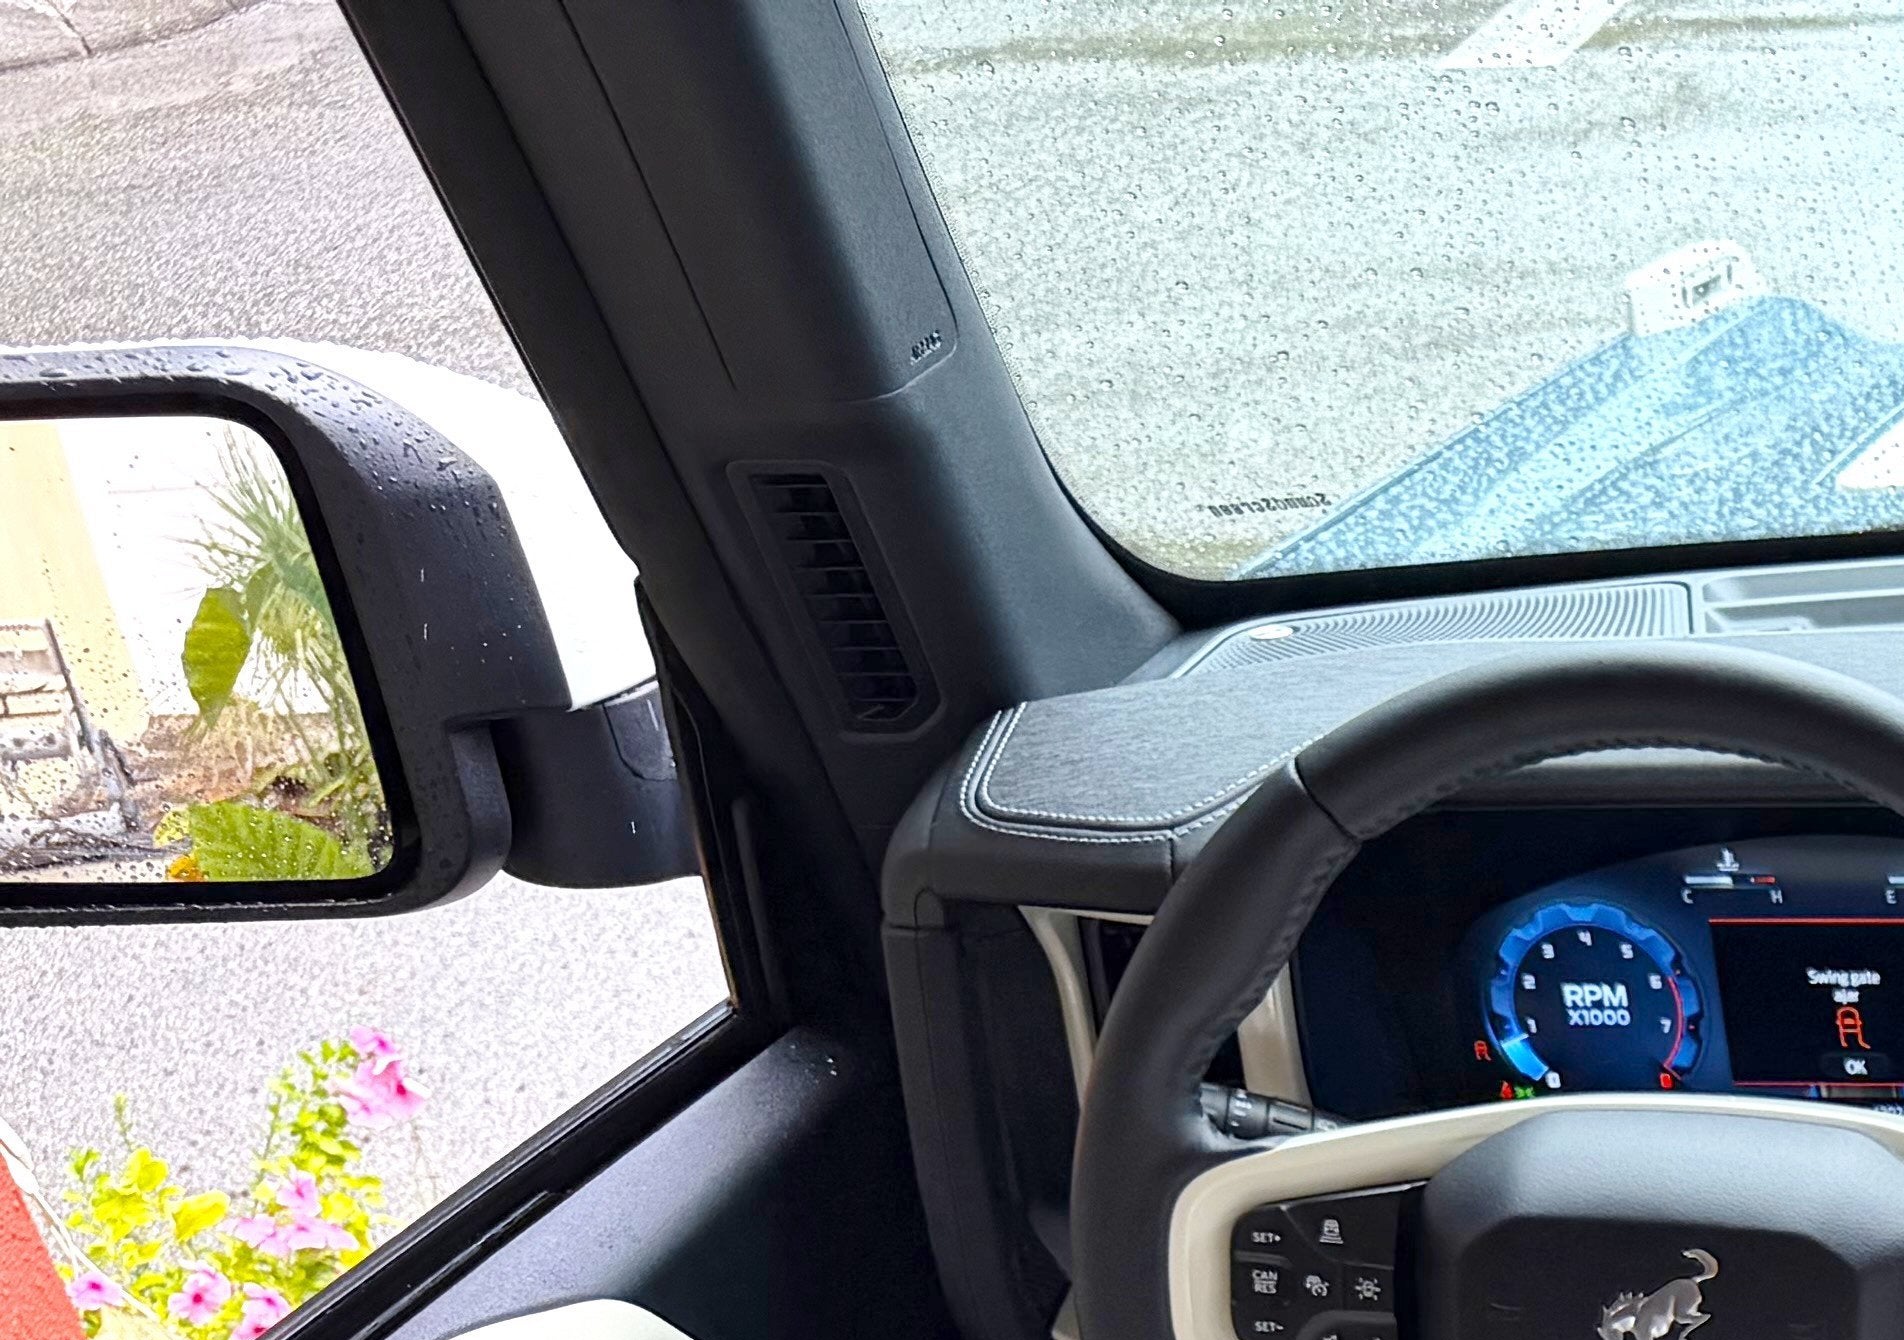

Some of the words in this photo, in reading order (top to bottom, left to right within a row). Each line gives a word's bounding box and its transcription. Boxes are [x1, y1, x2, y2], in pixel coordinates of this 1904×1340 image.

[1681, 888, 1694, 904] C
[1770, 889, 1783, 904] H
[1885, 888, 1897, 904] E
[1577, 930, 1592, 946] 4
[1541, 943, 1555, 959] 3
[1620, 943, 1634, 959] 5
[1521, 973, 1536, 990] 2
[1648, 973, 1662, 990] 6
[1806, 967, 1849, 987] Swing
[1850, 968, 1881, 987] gate
[1561, 982, 1629, 1008] RPM
[1526, 1017, 1537, 1034] 1
[1567, 1009, 1631, 1026] X1000
[1660, 1017, 1672, 1034] 7
[1843, 1057, 1868, 1075] OK
[1545, 1071, 1561, 1089] 0
[1252, 1269, 1278, 1281] CAN
[1253, 1283, 1277, 1294] RES
